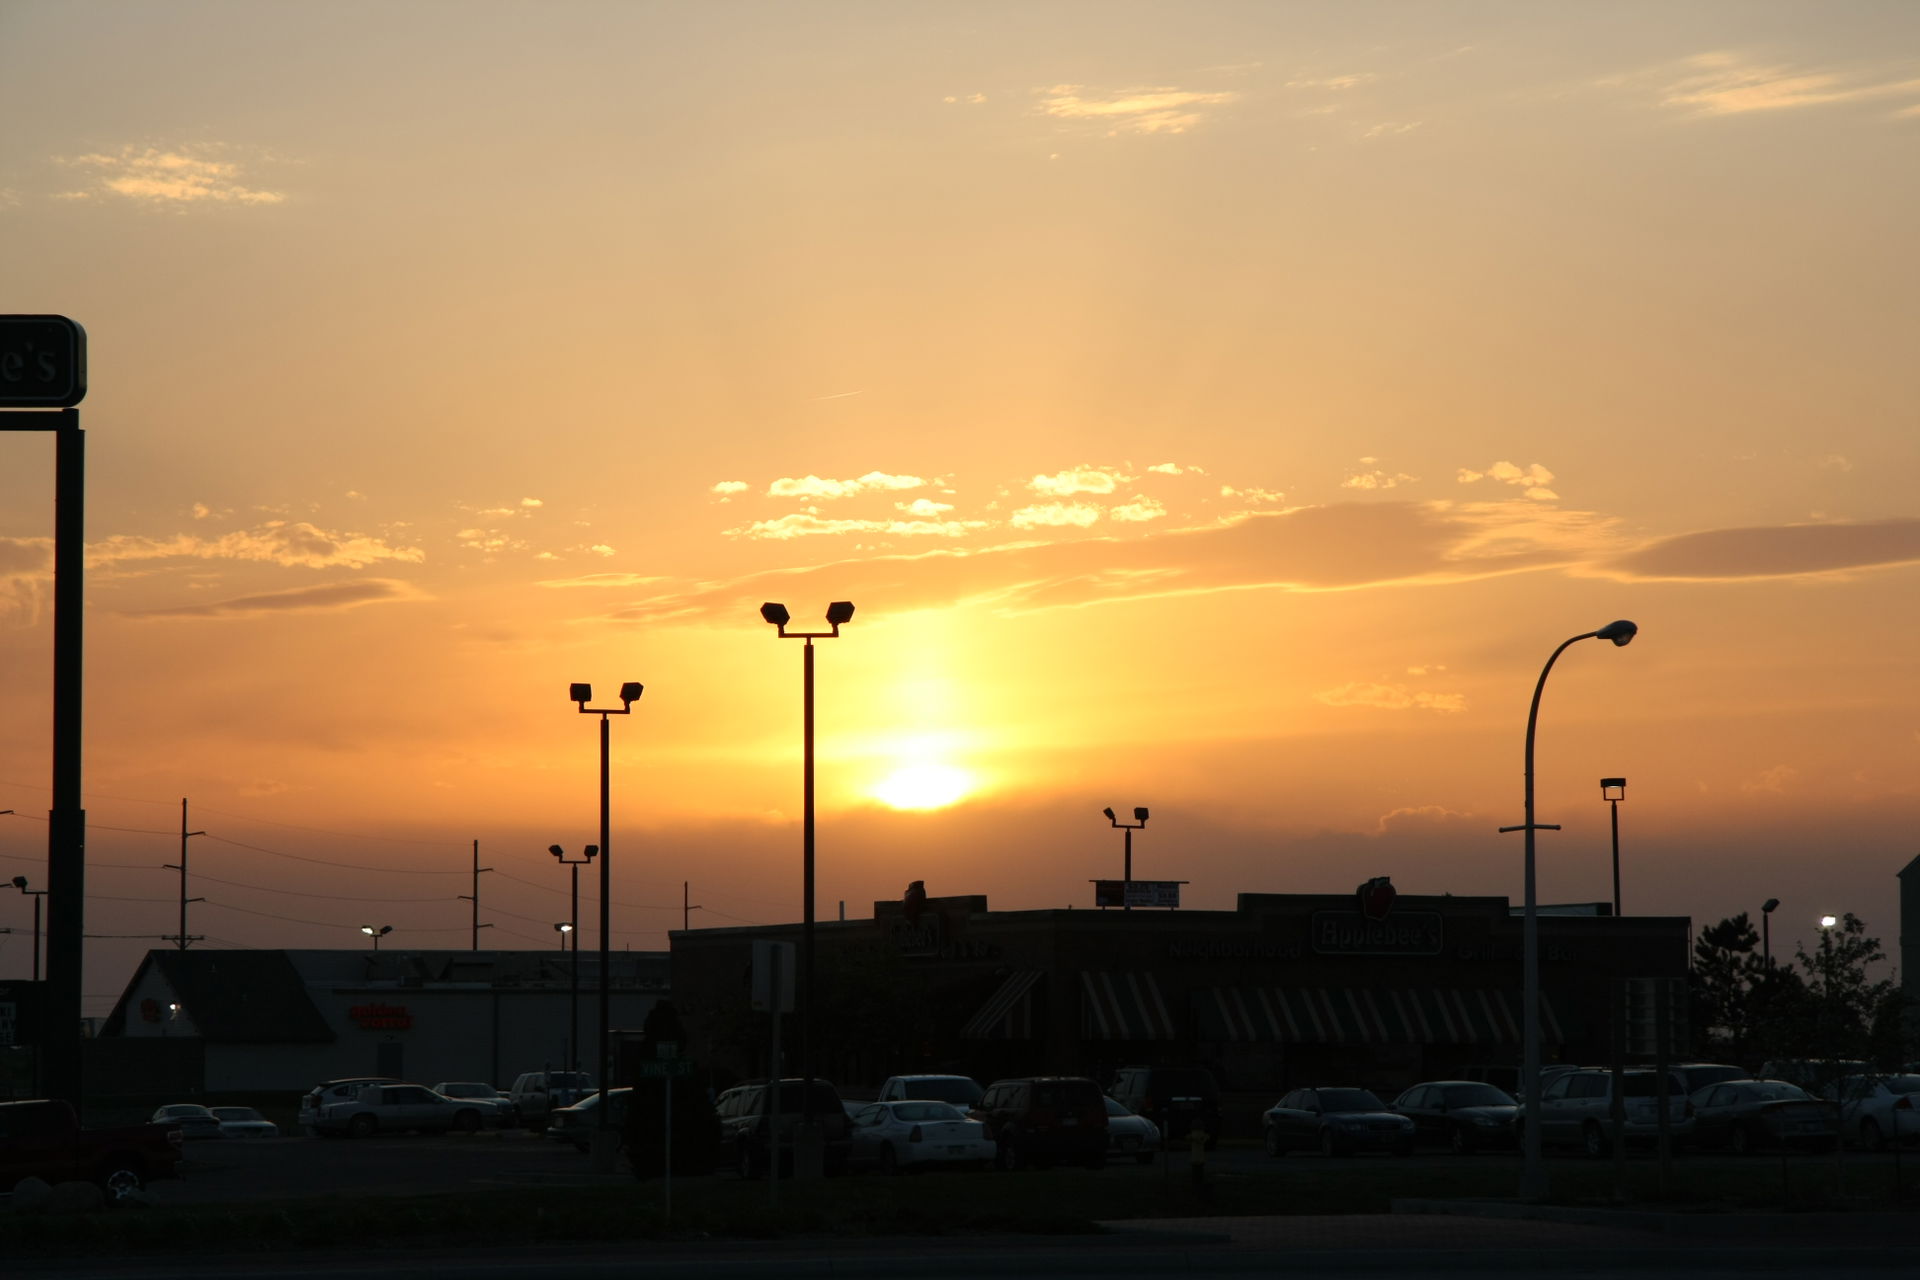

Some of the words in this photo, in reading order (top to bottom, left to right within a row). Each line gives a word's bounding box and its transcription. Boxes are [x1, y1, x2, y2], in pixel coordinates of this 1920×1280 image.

[1321, 920, 1440, 948] Applebee's
[641, 1062, 670, 1075] VINE
[678, 1061, 693, 1074] ST
